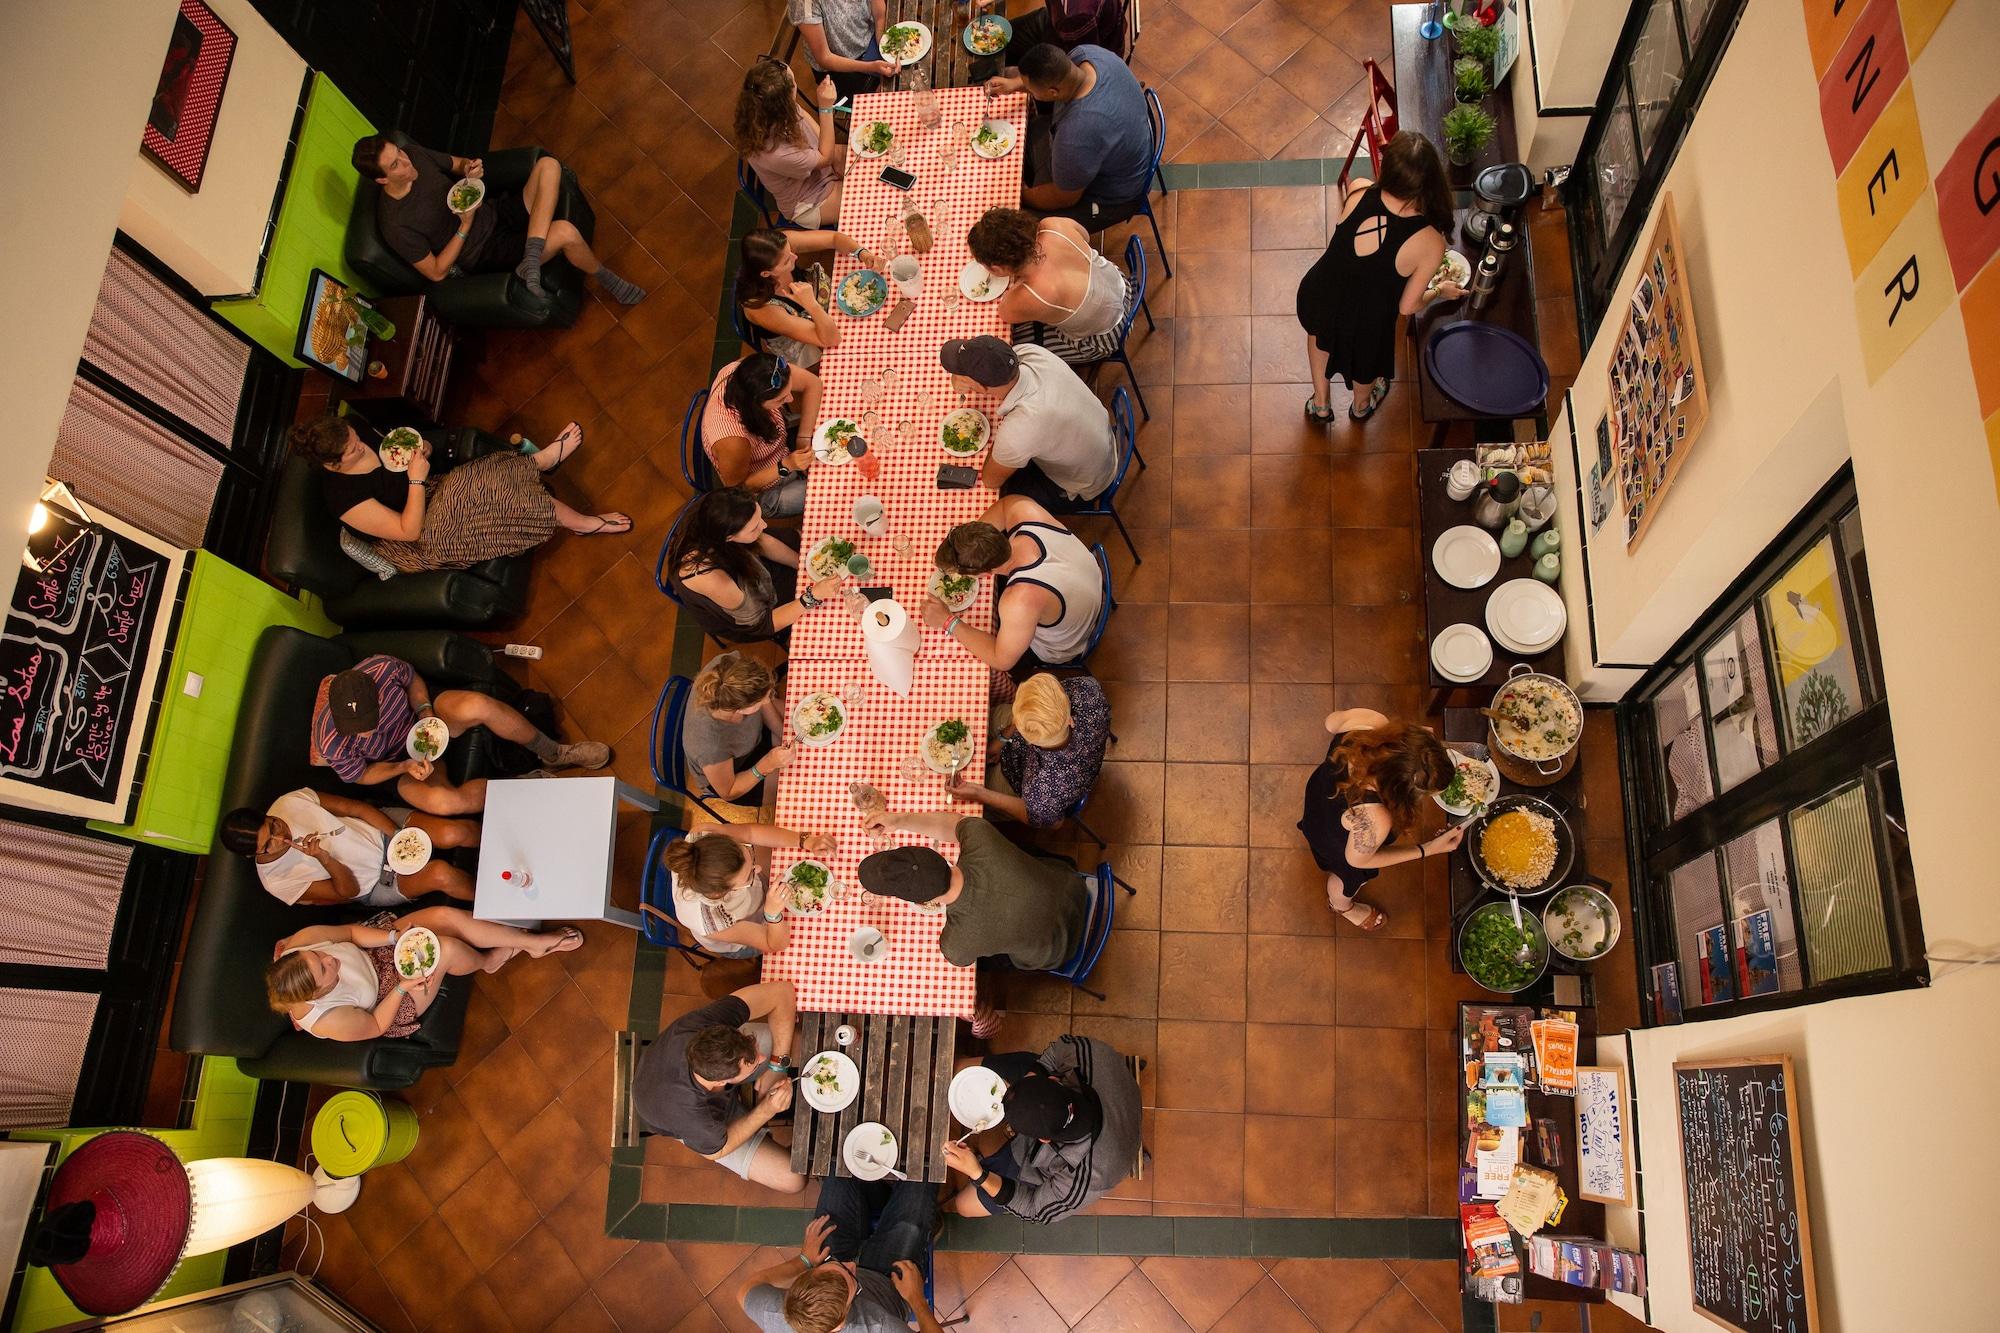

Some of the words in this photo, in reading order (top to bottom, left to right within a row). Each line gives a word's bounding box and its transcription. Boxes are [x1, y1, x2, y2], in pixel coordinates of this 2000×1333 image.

[1833, 0, 1920, 328] NER
[119, 572, 146, 607] Cruz
[8, 649, 42, 709] Setas
[75, 672, 89, 699] 3PM
[93, 685, 112, 701] the
[35, 710, 49, 733] 7PM
[91, 704, 108, 718] by
[77, 723, 100, 759] Picnic
[94, 716, 115, 761] River
[1760, 912, 1771, 952] FREE
[1547, 1043, 1566, 1051] TOURS
[1545, 1064, 1573, 1076] RENTALS
[1608, 1090, 1620, 1143] HAPPY
[1580, 1113, 1589, 1157] HOUR
[1484, 1173, 1510, 1181] FREE
[1487, 1165, 1510, 1174] GIFT
[1766, 1072, 1788, 1212] House
[1780, 1211, 1801, 1333] Rules
[1758, 1153, 1779, 1303] POSITIVE
